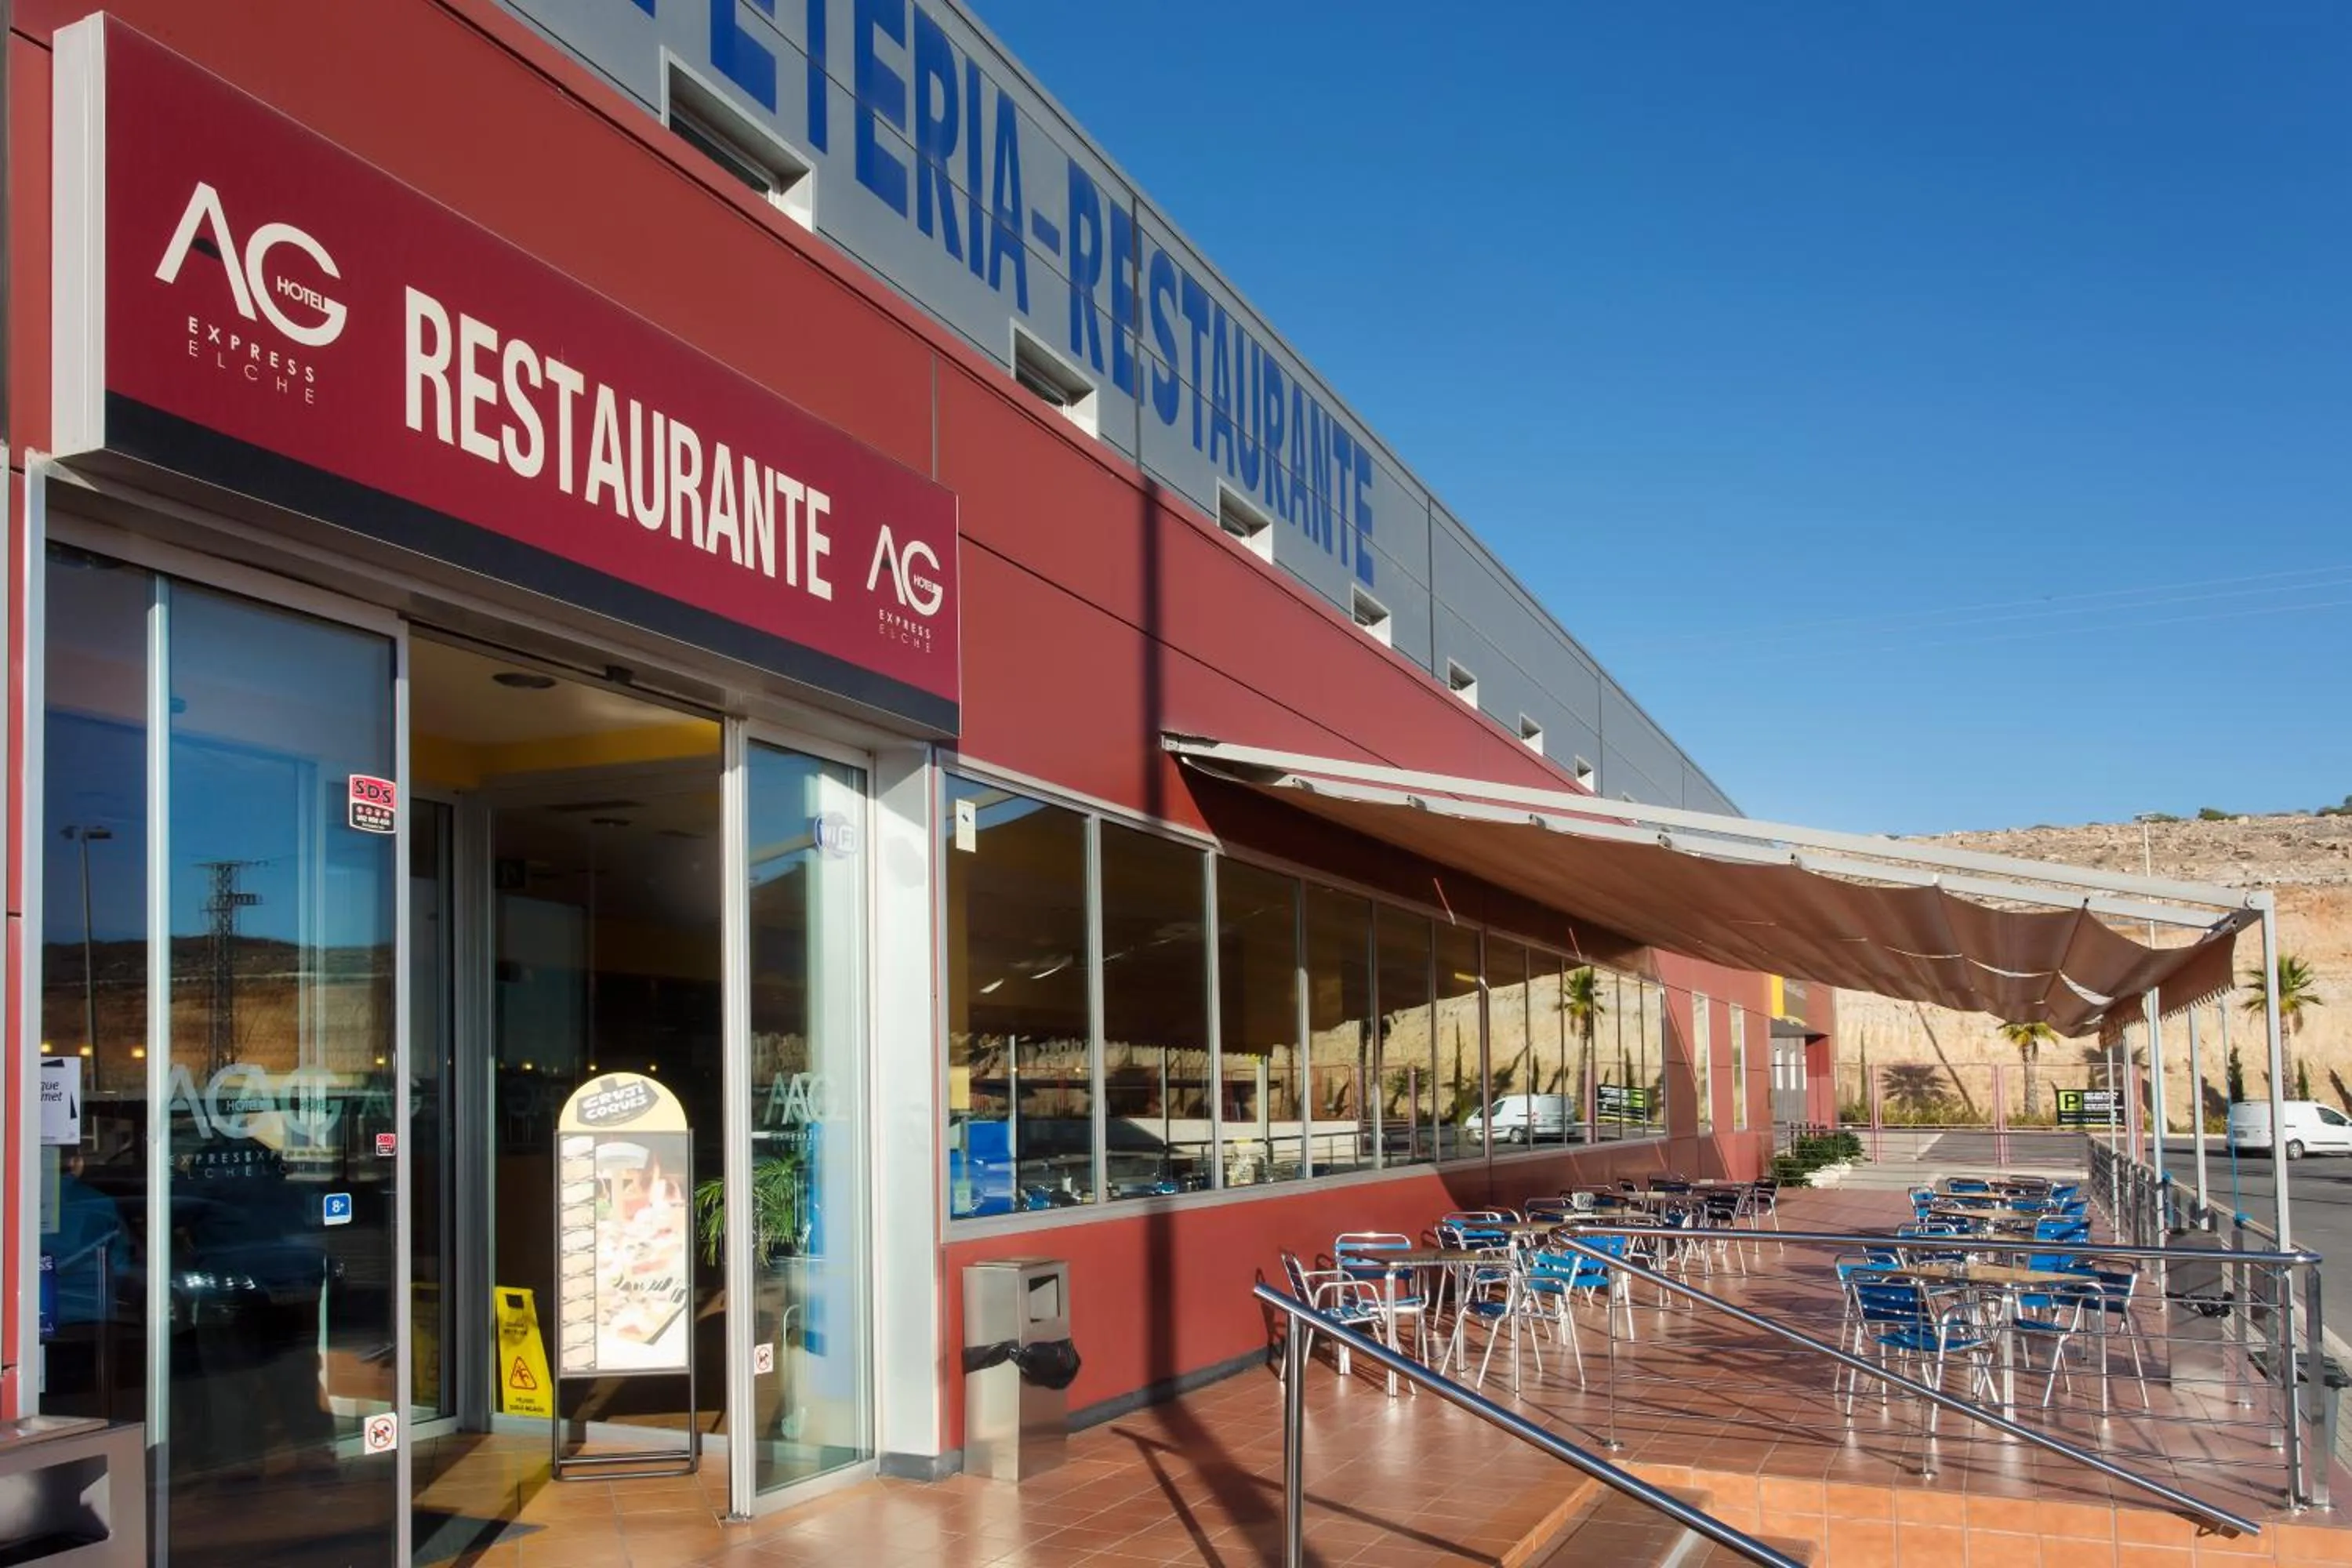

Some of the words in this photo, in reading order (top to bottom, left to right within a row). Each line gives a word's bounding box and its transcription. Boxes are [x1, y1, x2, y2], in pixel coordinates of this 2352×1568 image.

[155, 181, 347, 347] AG
[276, 275, 328, 310] HOTEL
[634, 0, 1374, 586] TERIA-RESTAURANTE
[187, 315, 315, 383] EXPRESS
[187, 339, 315, 404] ELCHE
[405, 285, 833, 601] RESTAURANTE
[866, 524, 943, 616] AG
[879, 608, 931, 640] EXPRESS
[879, 624, 932, 654] ELCHE
[355, 780, 391, 804] SDS
[2064, 1094, 2079, 1109] P
